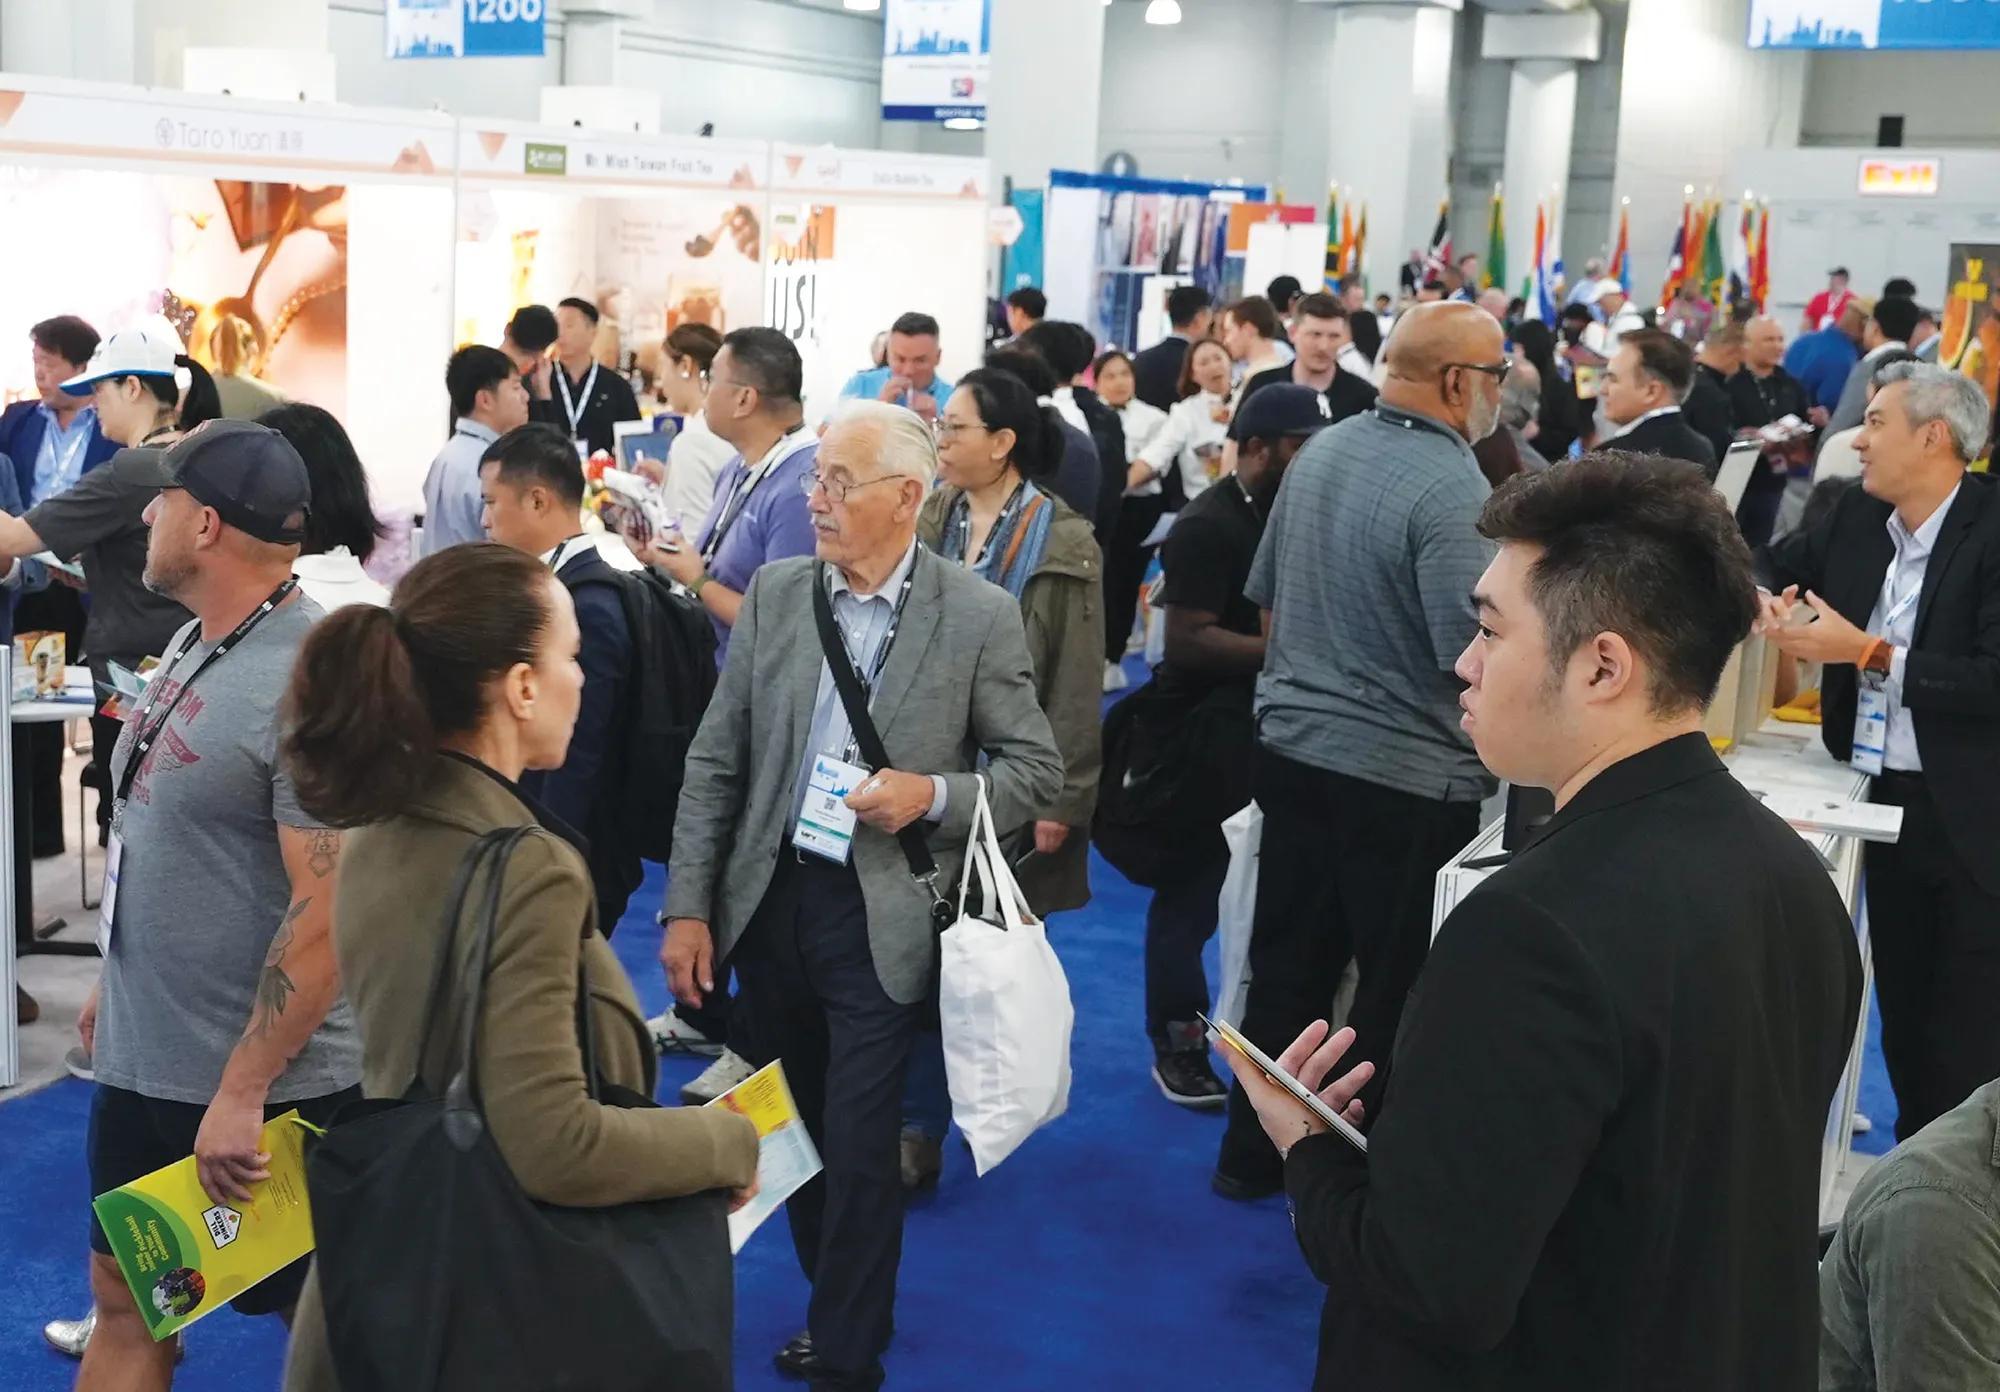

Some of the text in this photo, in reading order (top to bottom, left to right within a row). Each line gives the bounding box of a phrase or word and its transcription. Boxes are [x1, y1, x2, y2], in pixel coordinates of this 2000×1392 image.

[467, 0, 543, 23] 1200
[178, 121, 223, 149] Taro
[229, 127, 272, 152] Yuan
[772, 274, 816, 340] US!
[124, 1215, 147, 1253] Pickleball
[146, 1218, 170, 1261] Community
[210, 1221, 221, 1237] DILL
[213, 1210, 230, 1240] DINKERS
